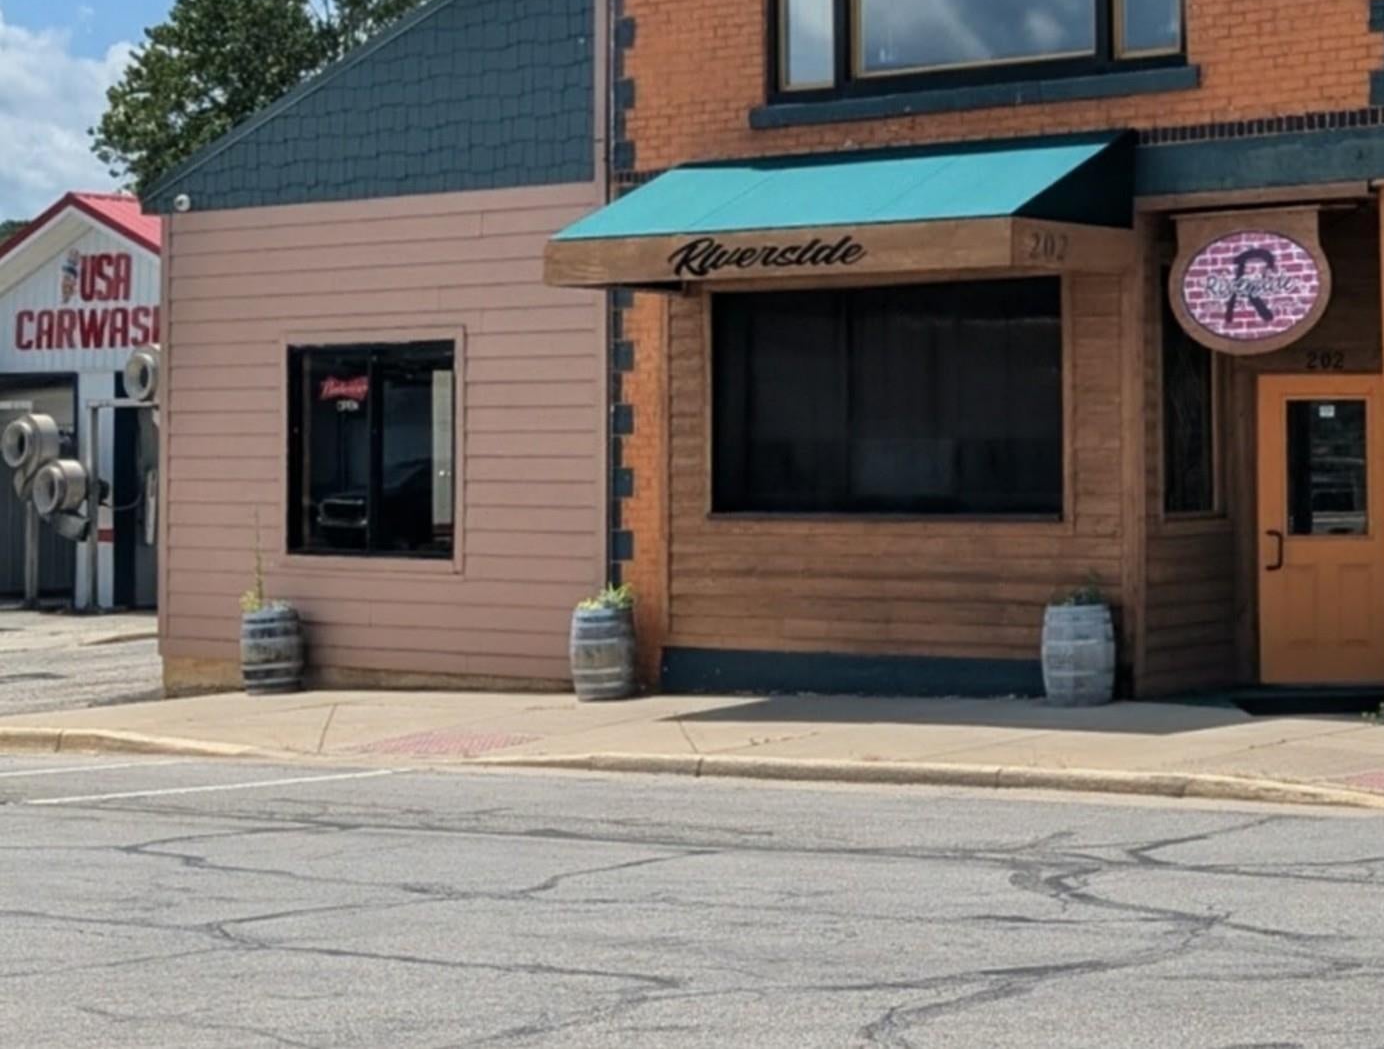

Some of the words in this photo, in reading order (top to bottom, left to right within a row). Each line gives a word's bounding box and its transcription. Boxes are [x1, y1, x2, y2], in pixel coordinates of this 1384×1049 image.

[668, 236, 867, 276] Riverside
[1029, 231, 1070, 262] 202
[80, 253, 132, 301] USA
[1306, 351, 1345, 370] 202
